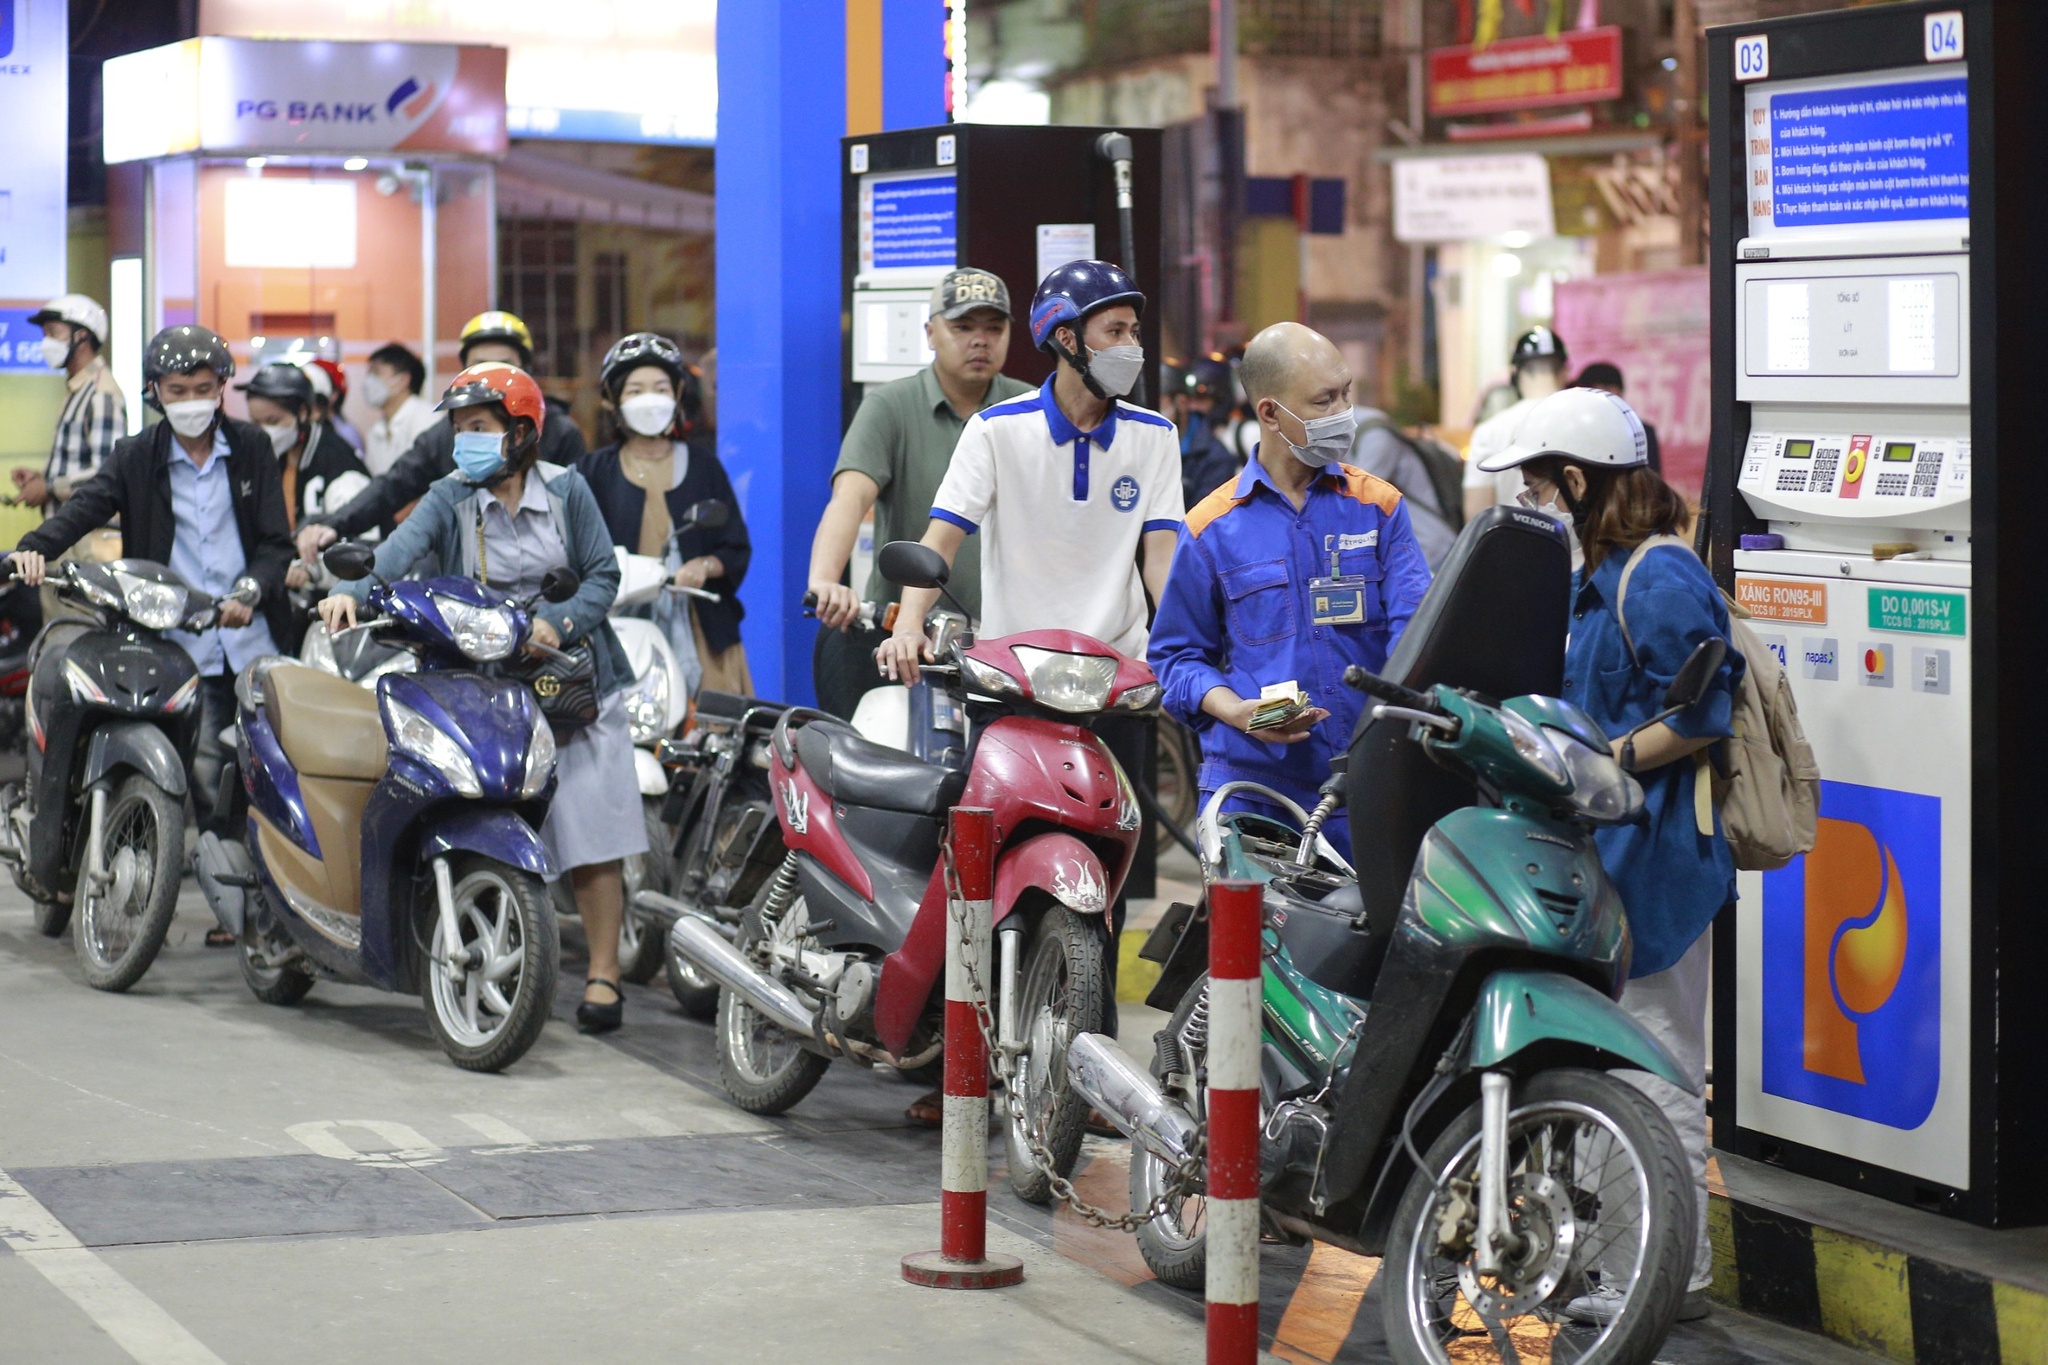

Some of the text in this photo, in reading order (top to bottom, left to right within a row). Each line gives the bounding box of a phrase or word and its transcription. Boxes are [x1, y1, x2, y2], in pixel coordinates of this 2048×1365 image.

[1931, 20, 1958, 52] 04
[1741, 42, 1763, 73] 03
[236, 99, 377, 123] PG BANK
[1753, 108, 1766, 126] QUY
[1750, 136, 1770, 156] TRÌNH
[1754, 166, 1768, 186] BÁN
[1753, 197, 1771, 216] HÀNG
[1512, 513, 1556, 533] HONDA
[1740, 582, 1822, 607] XĂNG RON95-III
[1750, 604, 1768, 615] TCCS
[1769, 605, 1776, 616] 01
[1782, 606, 1813, 619] 2015/PLX
[1881, 595, 1951, 617] DO 0,001S-V
[1882, 614, 1902, 627] TCCS
[1805, 652, 1828, 666] napas
[394, 773, 424, 797] HONDA
[1301, 1038, 1325, 1062] 125
